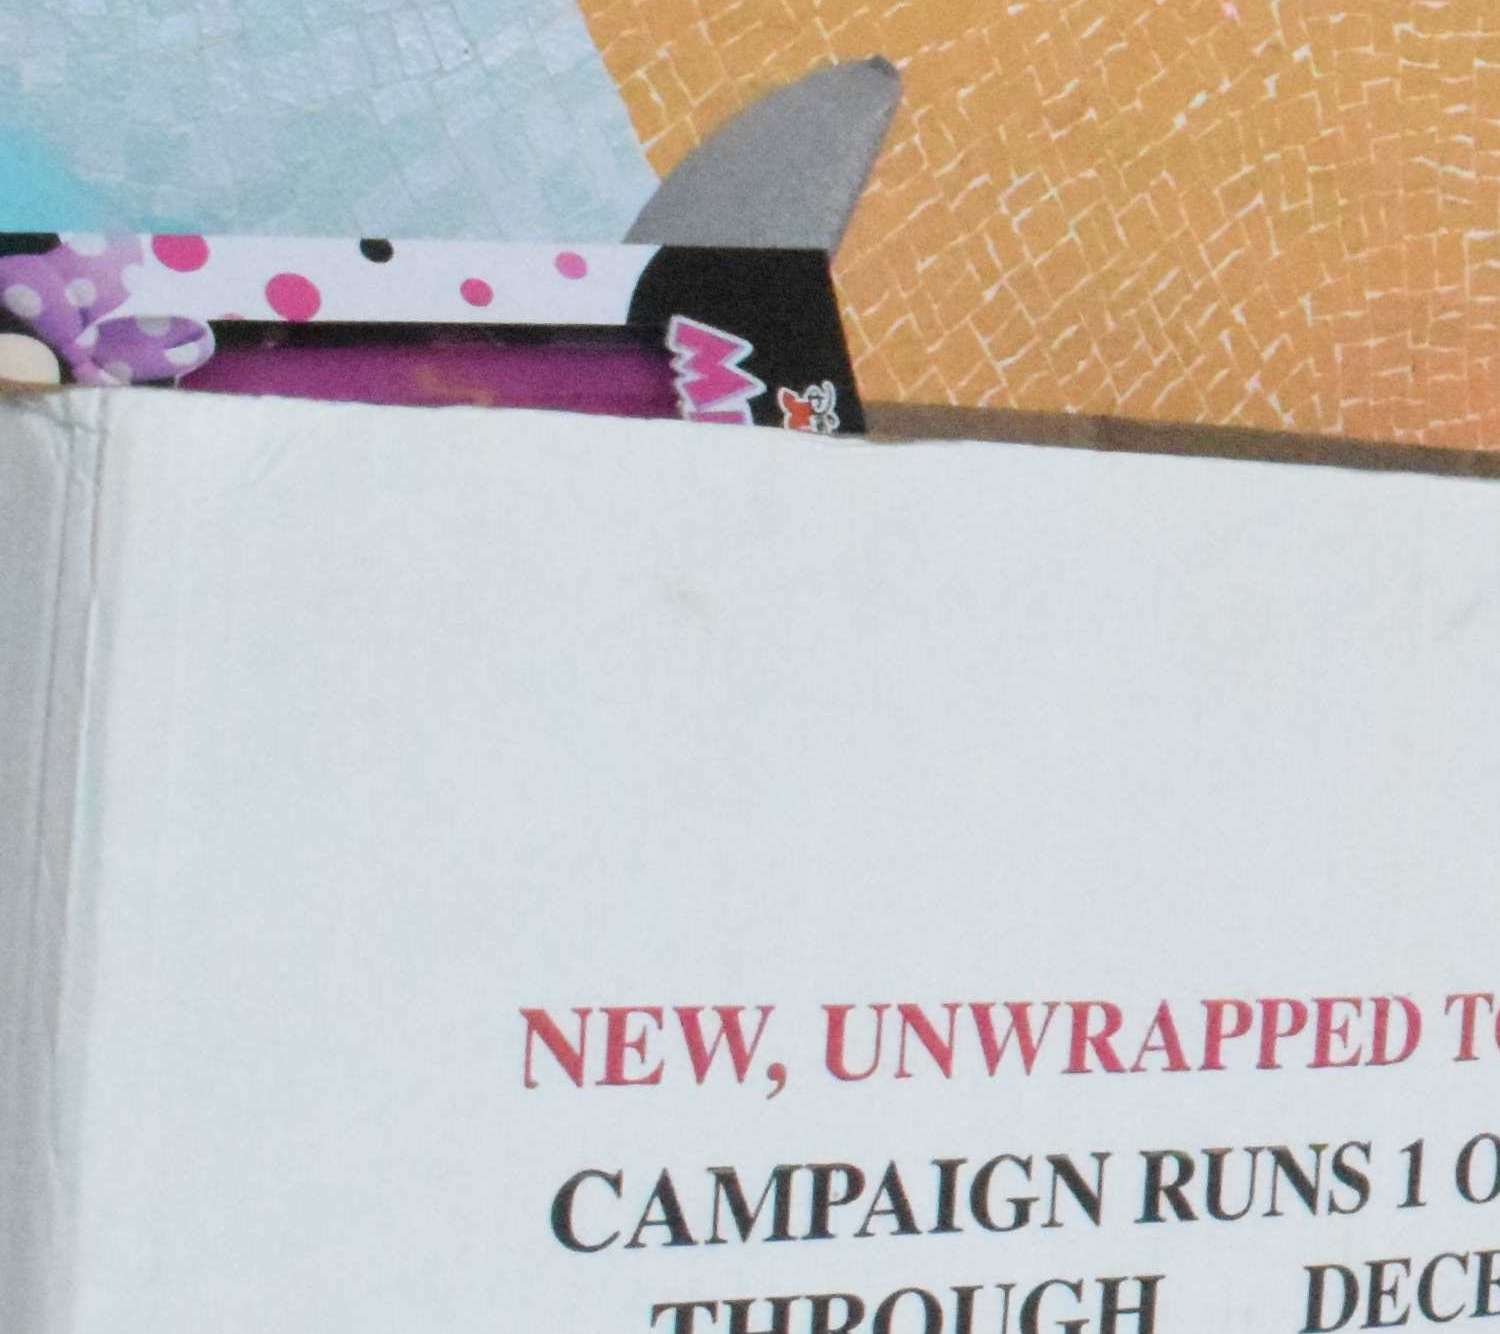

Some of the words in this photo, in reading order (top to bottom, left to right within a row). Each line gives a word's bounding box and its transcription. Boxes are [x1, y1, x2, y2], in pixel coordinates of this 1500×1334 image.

[519, 1003, 790, 1101] NEW,
[820, 993, 1424, 1083] UNWRAPPED
[549, 1150, 1113, 1253] CAMPAIGN
[1134, 1140, 1373, 1225] RUNS
[1399, 1138, 1426, 1210] 1
